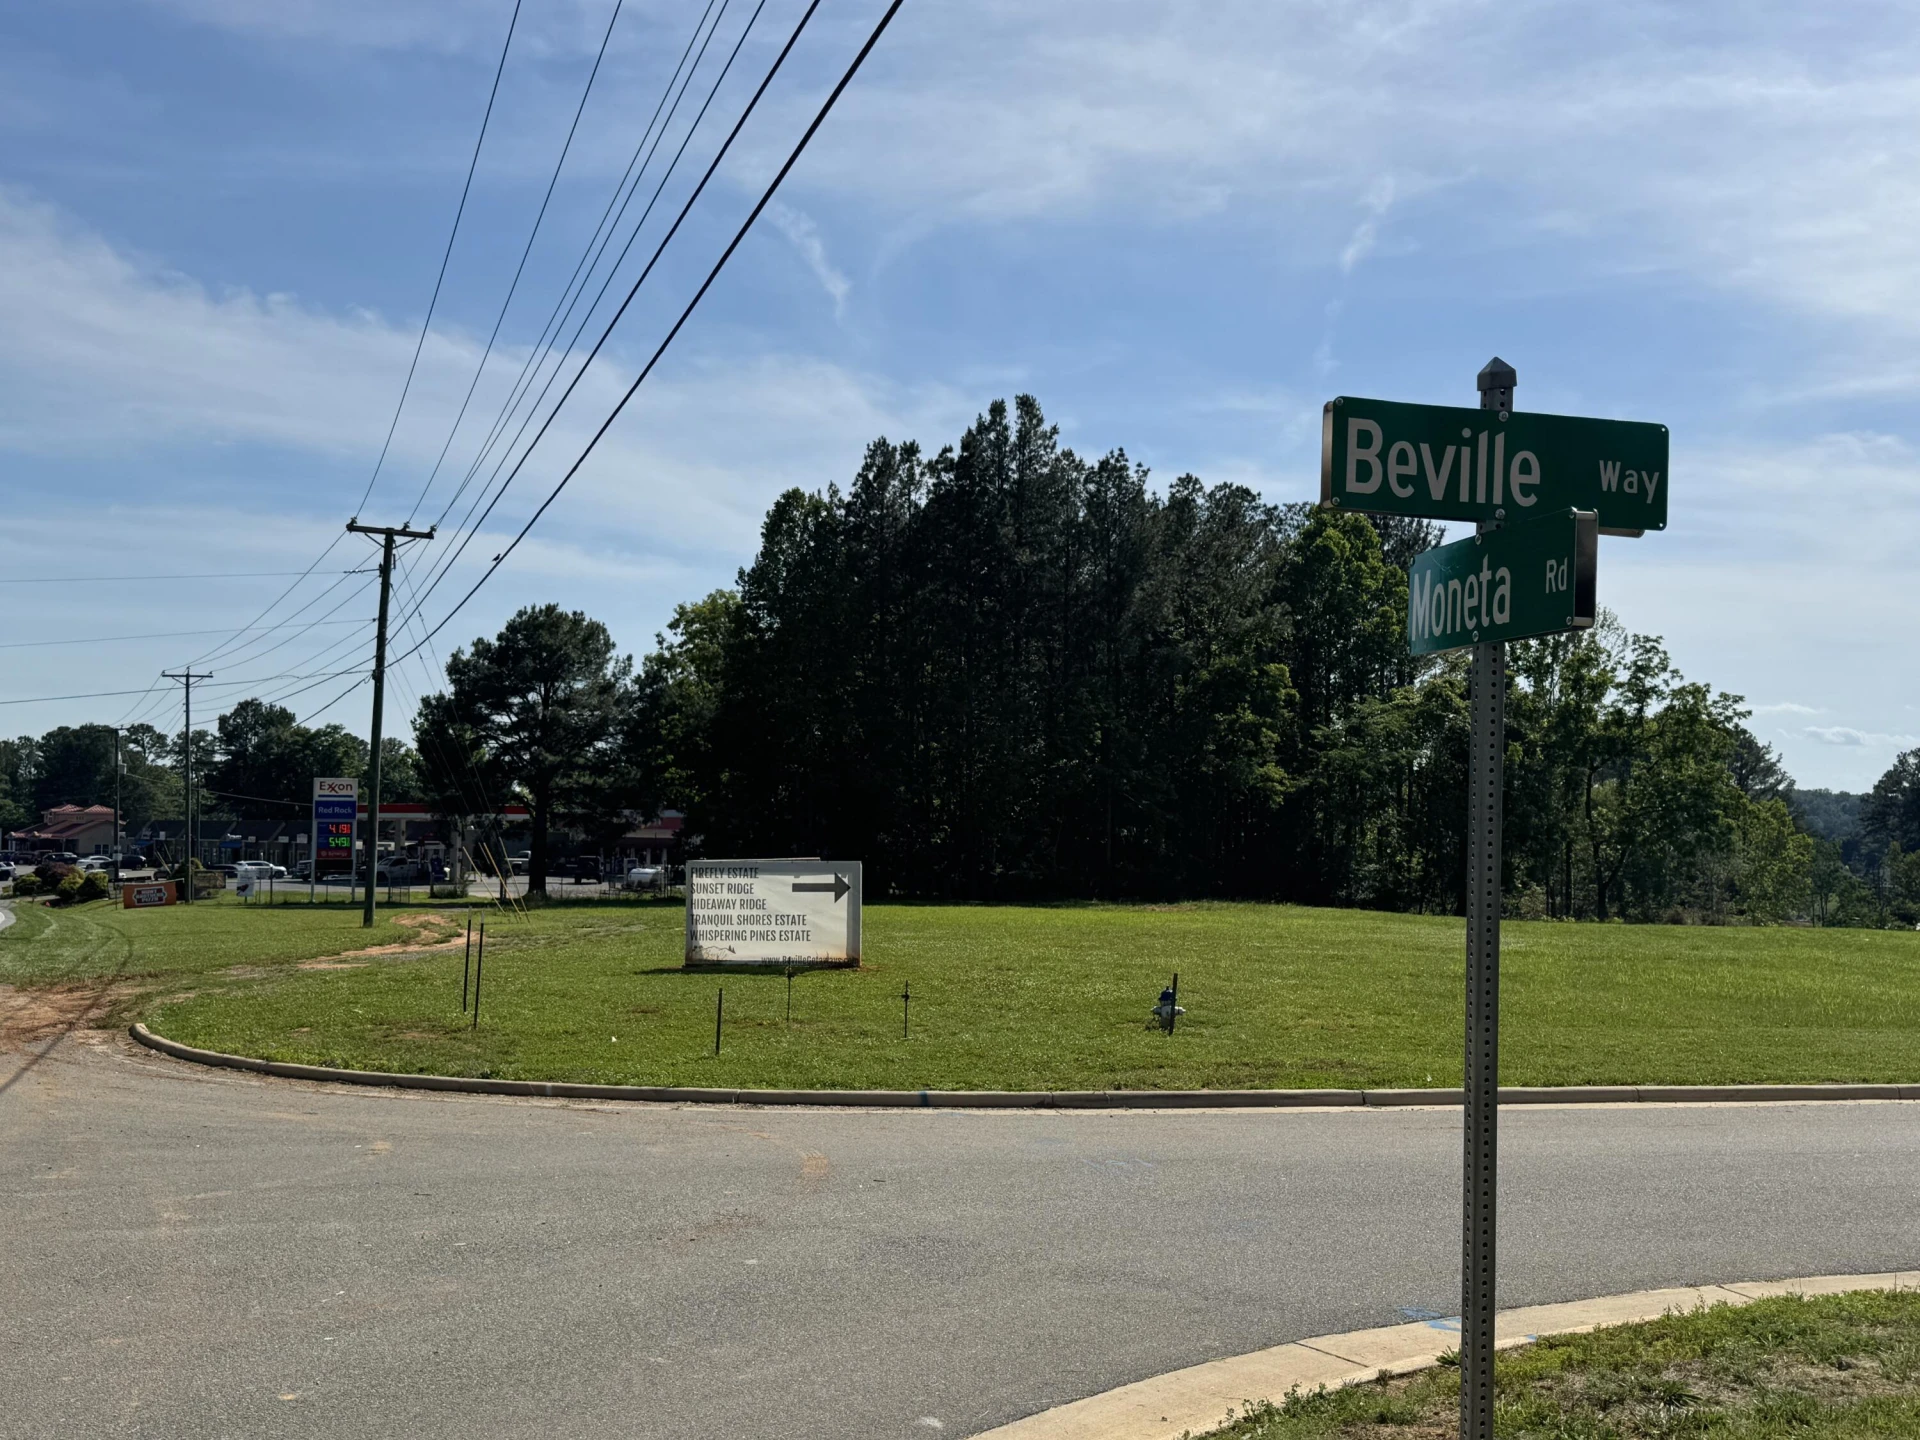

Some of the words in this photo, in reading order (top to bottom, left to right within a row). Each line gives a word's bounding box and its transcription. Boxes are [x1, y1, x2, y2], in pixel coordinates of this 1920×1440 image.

[1345, 417, 1541, 507] Beville
[1599, 459, 1660, 504] Way
[1411, 554, 1511, 641] Moneta
[1545, 556, 1568, 594] Rd
[319, 781, 353, 794] Exxon
[318, 806, 333, 814] Red
[334, 806, 352, 814] Rock
[690, 867, 725, 879] FIREFLY
[727, 867, 759, 879] ESTATE
[690, 883, 725, 895] SUNSET
[727, 883, 754, 894] RIDGE
[690, 899, 737, 910] HIDEAWAY
[739, 899, 767, 910] RIDGE
[690, 914, 734, 927] TRANQUIL
[736, 914, 772, 926] SHORES
[775, 914, 807, 926] ESTATE
[690, 929, 747, 942] WHISPERING
[749, 929, 776, 942] PINES
[779, 929, 811, 942] ESTATE
